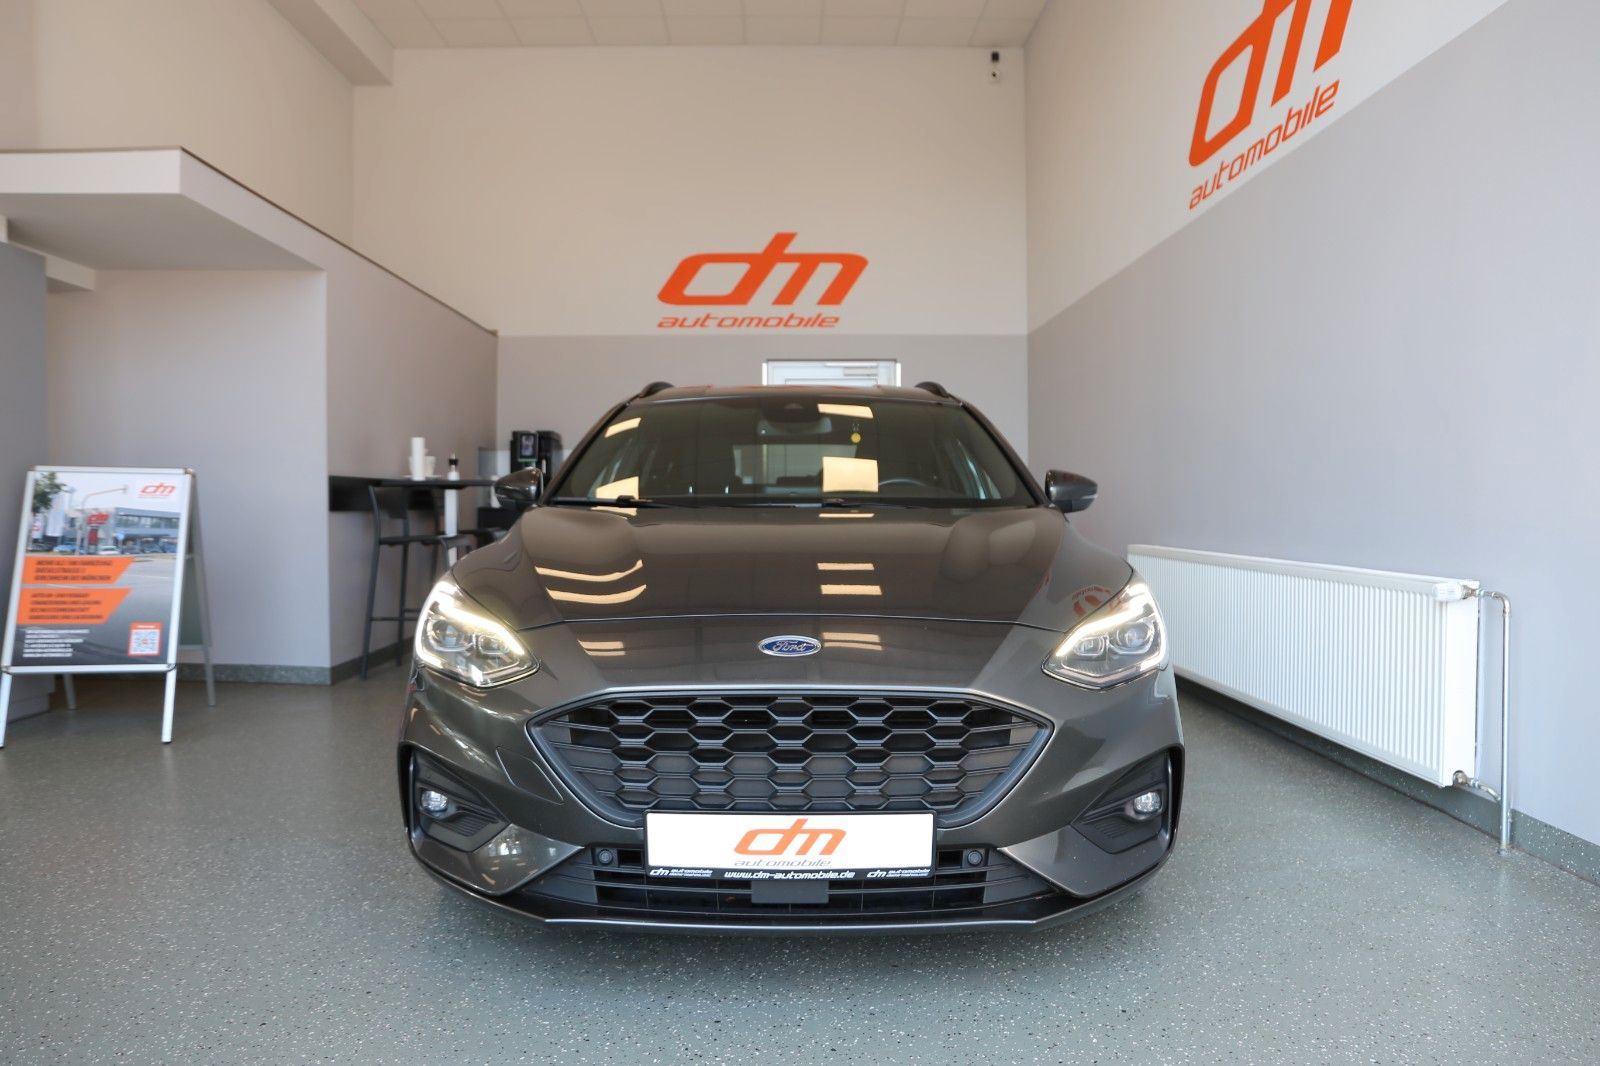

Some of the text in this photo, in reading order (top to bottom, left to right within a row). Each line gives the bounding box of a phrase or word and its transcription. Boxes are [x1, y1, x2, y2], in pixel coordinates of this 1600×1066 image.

[1189, 0, 1353, 167] dm
[1189, 79, 1340, 210] automobile
[657, 232, 869, 305] dm
[657, 313, 840, 328] automobile
[140, 482, 176, 494] dm
[734, 818, 847, 855] dm
[734, 859, 832, 867] automobile
[650, 868, 670, 876] dm
[724, 870, 856, 880] www.dm-automobile.de
[866, 870, 887, 878] dm
